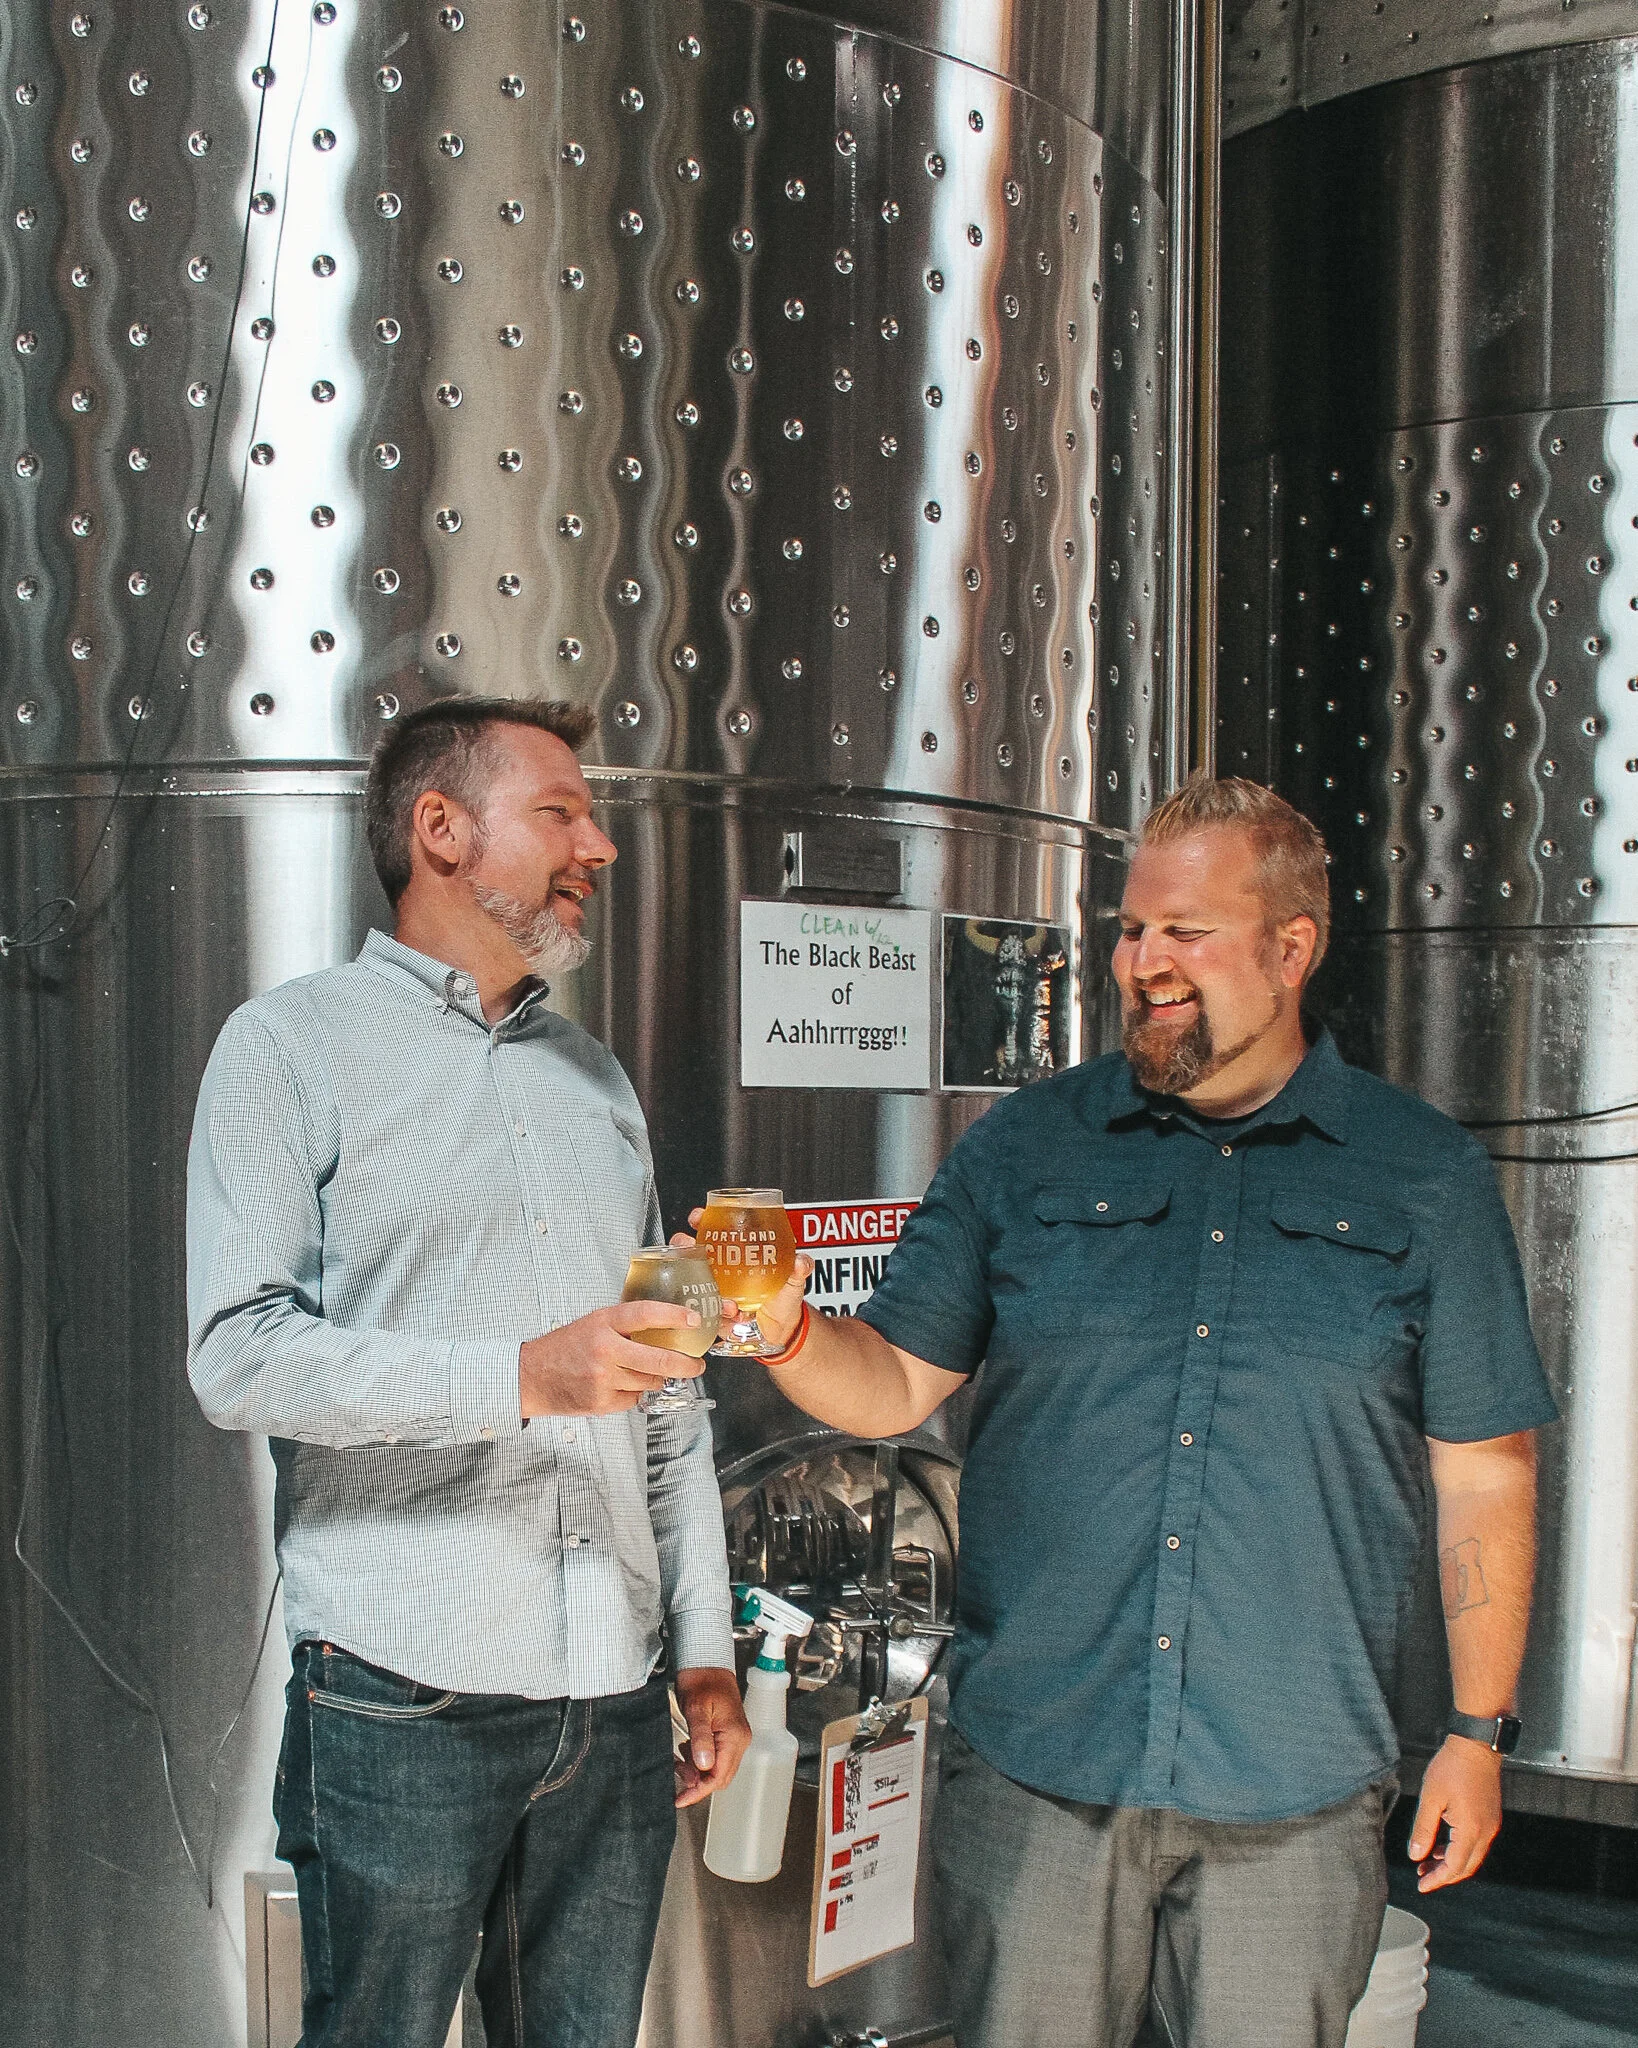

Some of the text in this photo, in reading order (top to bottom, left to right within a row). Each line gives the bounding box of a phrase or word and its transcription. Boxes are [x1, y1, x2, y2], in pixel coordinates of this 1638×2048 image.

[800, 912, 859, 937] CLEAN
[760, 941, 917, 971] The Black Beast
[831, 982, 853, 1005] of
[766, 1018, 907, 1051] Aahhrrrggg!!
[705, 1230, 777, 1242] PORTLAND
[705, 1243, 778, 1266] CIDER
[713, 1268, 778, 1276] OMPANY
[804, 1255, 890, 1296] NFIN
[685, 1295, 722, 1319] CID
